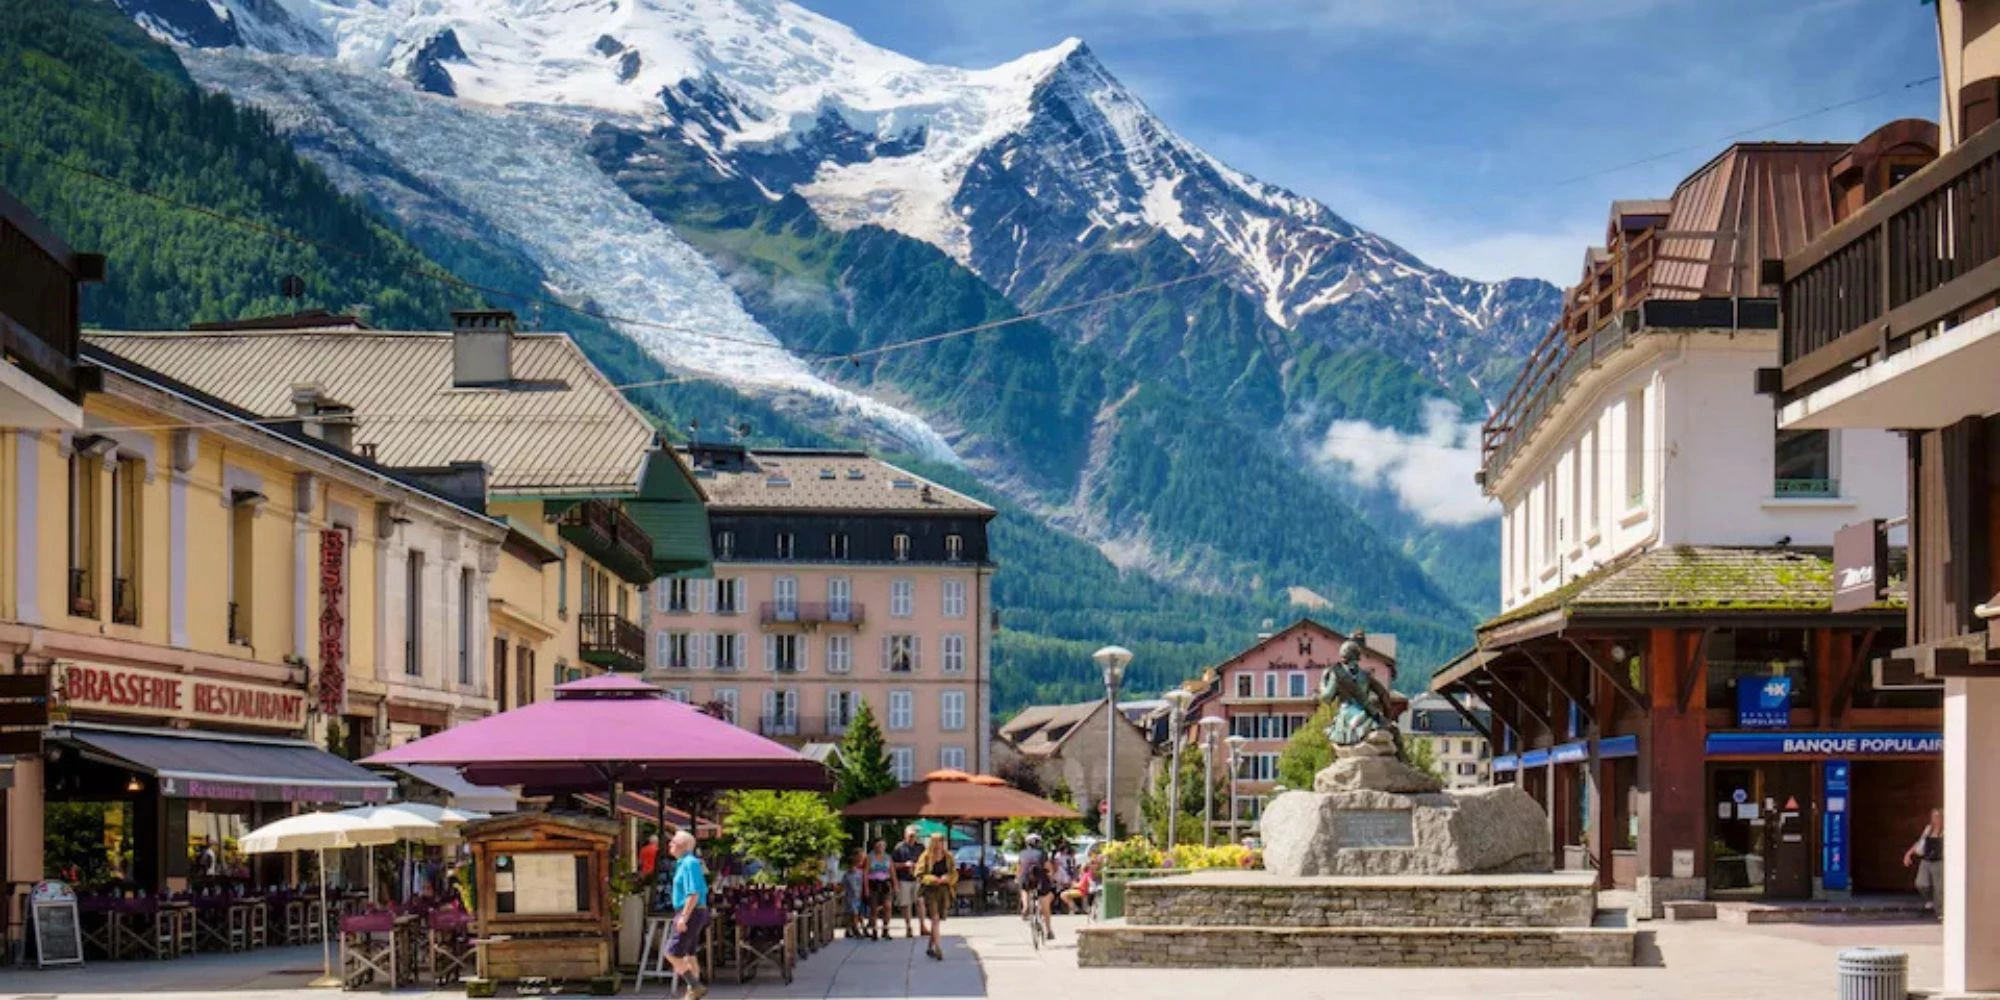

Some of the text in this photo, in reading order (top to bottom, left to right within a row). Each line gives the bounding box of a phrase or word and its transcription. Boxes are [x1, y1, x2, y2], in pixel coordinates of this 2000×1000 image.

[320, 530, 343, 714] RESTAURANT
[68, 667, 303, 722] BRASSERIE RESTAURANT
[1783, 738, 1857, 754] BANQUE
